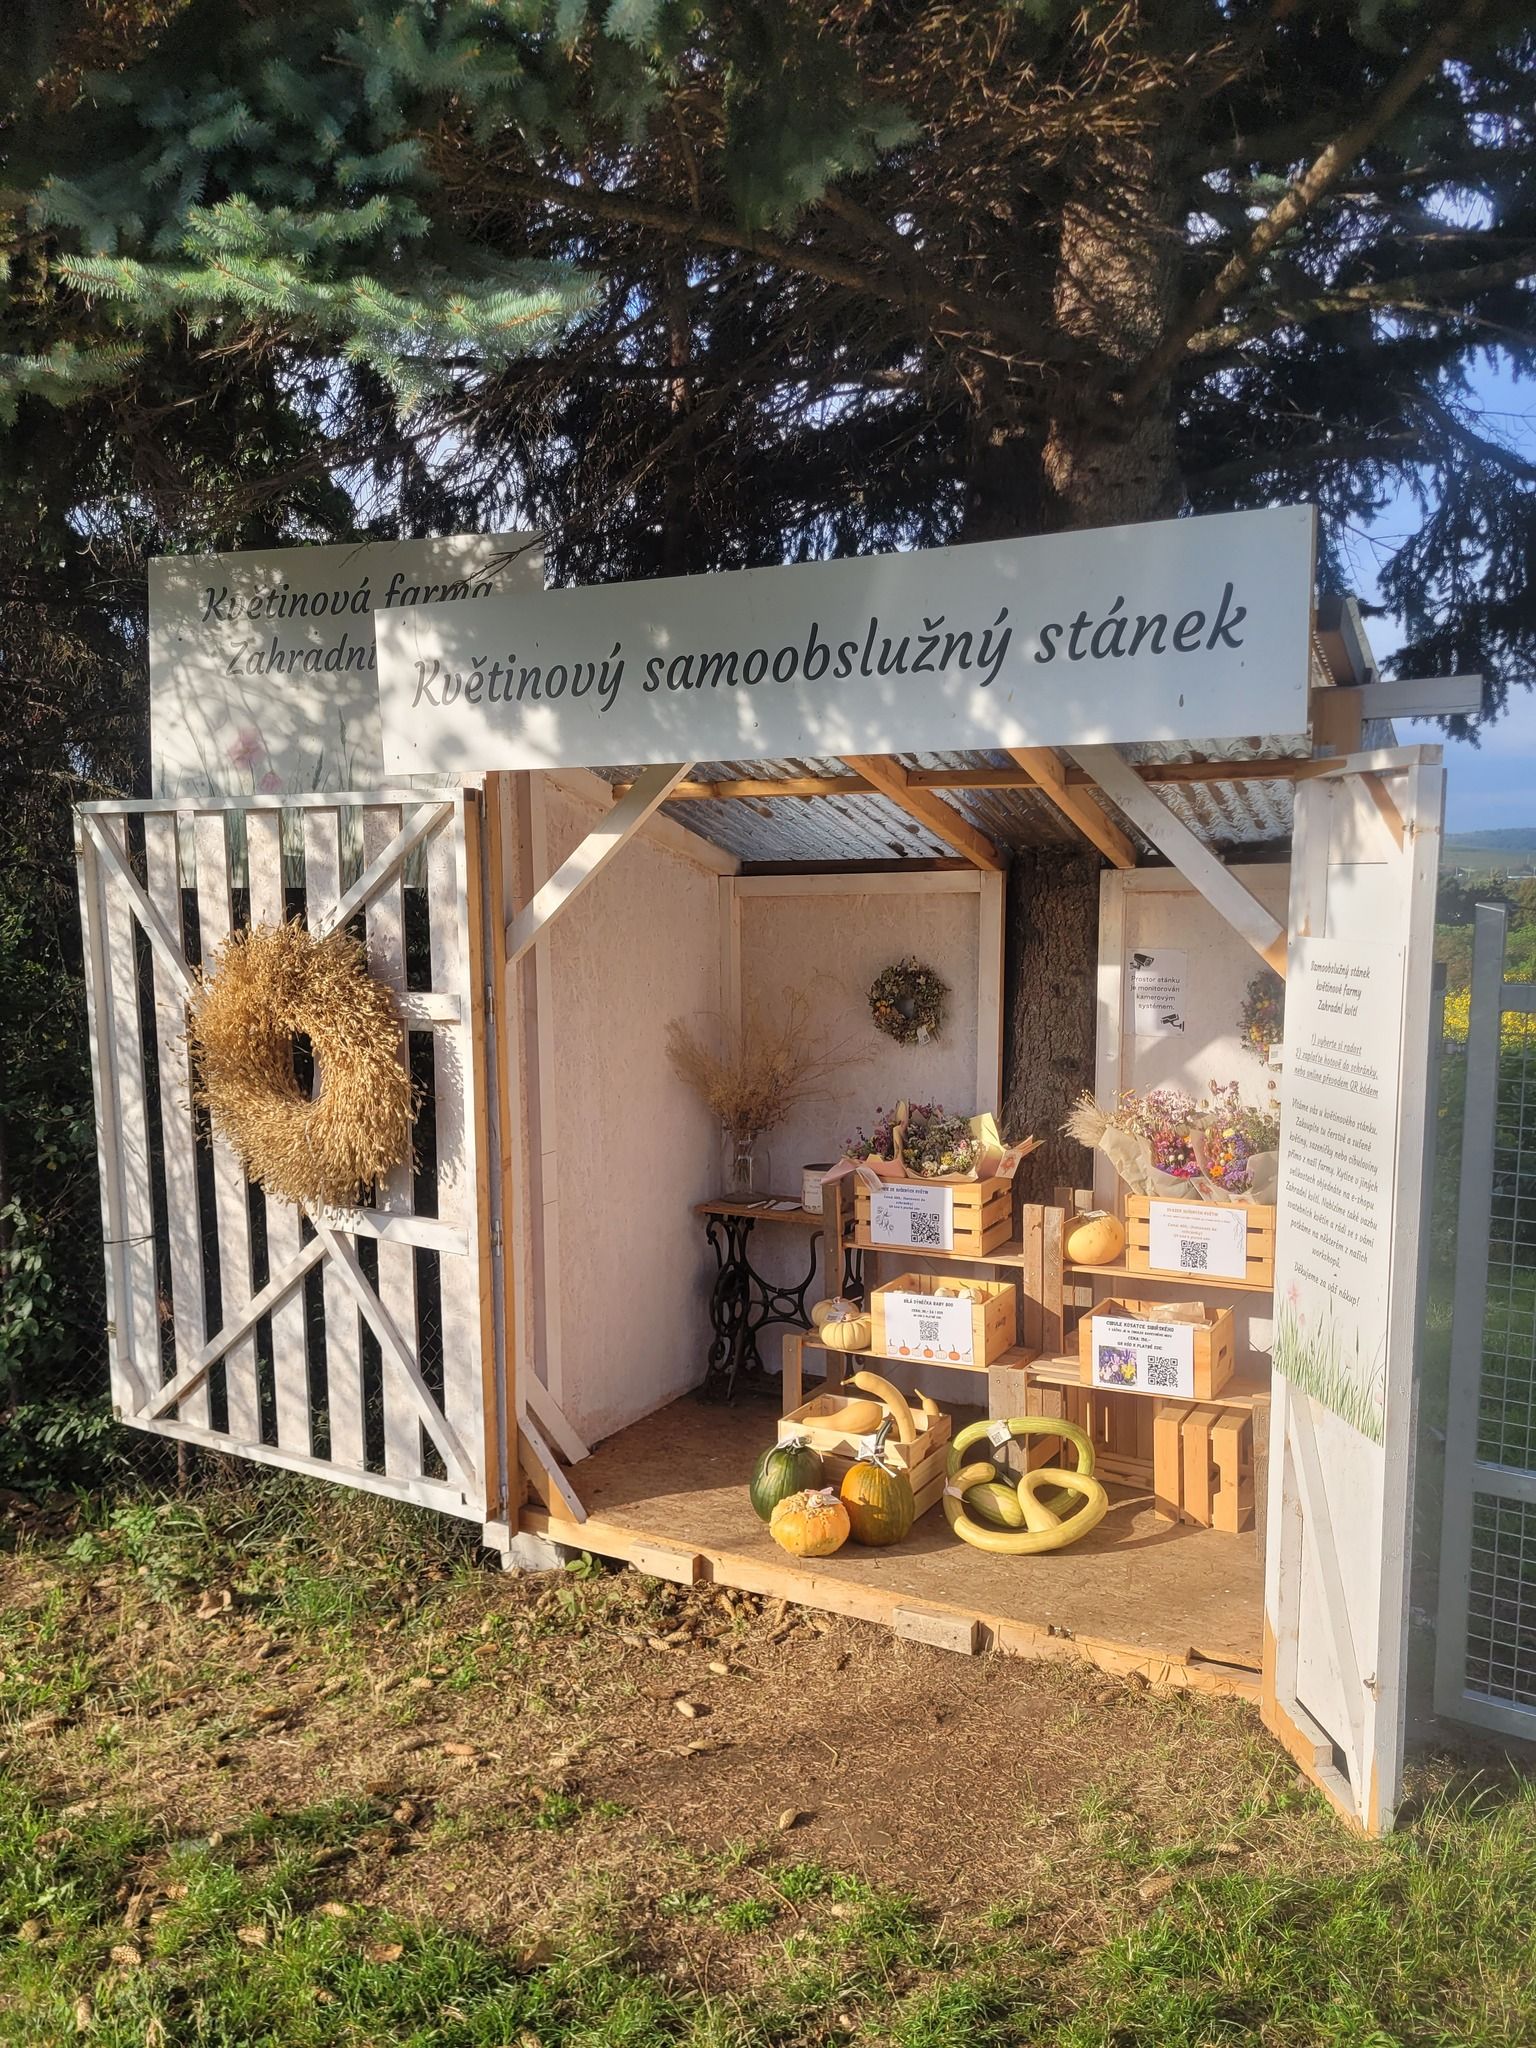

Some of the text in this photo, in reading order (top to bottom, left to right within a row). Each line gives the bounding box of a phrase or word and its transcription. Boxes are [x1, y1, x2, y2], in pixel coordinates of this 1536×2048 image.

[203, 572, 493, 623] Květinová farma
[226, 633, 377, 677] Zahradní
[412, 581, 1248, 713] Květinový samoobslužný stánek
[1311, 960, 1370, 979] Samoobslužný stánek
[1137, 993, 1175, 1002] kamerovým
[1316, 980, 1361, 1000] květinové farmy
[1318, 1000, 1344, 1014] Zahradní
[1302, 1051, 1323, 1064] zaplaťte
[1324, 1053, 1342, 1068] hotově
[1342, 1059, 1349, 1070] do
[1317, 1035, 1337, 1049] vyberte
[1338, 1041, 1342, 1049] si
[1344, 1043, 1362, 1055] radost
[1295, 1065, 1378, 1097] nebo online převodem QR kódem
[1292, 1098, 1309, 1112] Vítáme
[1309, 1105, 1318, 1115] vás
[1324, 1108, 1355, 1128] květinového
[1357, 1121, 1378, 1135] stánku.
[1296, 1116, 1319, 1134] Zakoupíte
[1320, 1128, 1326, 1136] tu
[1327, 1128, 1346, 1143] čerstvé
[1352, 1139, 1371, 1152] sušené
[1288, 1149, 1302, 1161] přímo
[1307, 1158, 1317, 1168] naší
[1318, 1159, 1334, 1176] farmy.
[1336, 1167, 1354, 1181] Kytice
[1359, 1177, 1378, 1192] jiných
[1309, 1141, 1333, 1158] sazeničky
[1334, 1150, 1347, 1162] nebo
[1348, 1155, 1378, 1176] cibuloviny
[1285, 1181, 1307, 1198] Zahradní
[1321, 1197, 1346, 1216] Nabízíme
[1346, 1210, 1359, 1223] také
[1360, 1216, 1378, 1231] vazbu
[1289, 1168, 1375, 1210] velikostech objednáte na e-shopu
[1287, 1200, 1313, 1218] svatebních
[1313, 1211, 1329, 1226] květin
[1335, 1222, 1347, 1235] rádi
[1347, 1230, 1354, 1239] se
[1360, 1234, 1375, 1248] vámi
[1312, 1230, 1319, 1239] na
[1320, 1233, 1344, 1252] některém
[1349, 1248, 1368, 1264] našich
[1294, 1261, 1360, 1307] Děkujeme za váš nákup!
